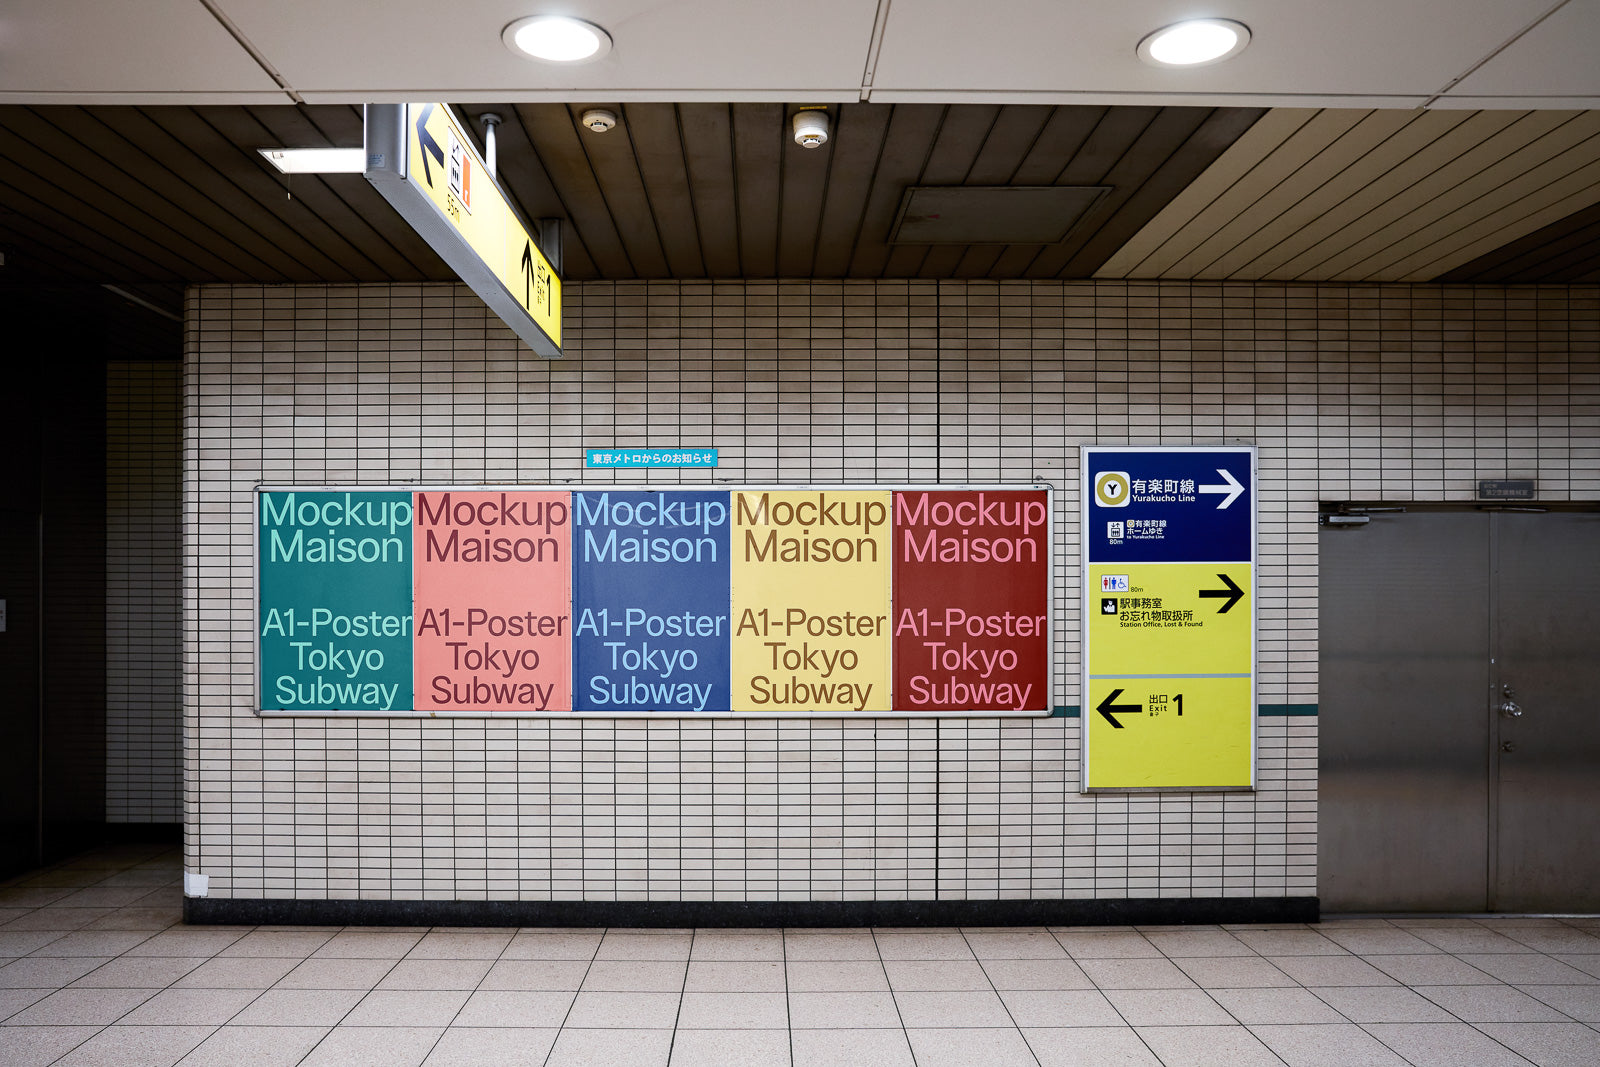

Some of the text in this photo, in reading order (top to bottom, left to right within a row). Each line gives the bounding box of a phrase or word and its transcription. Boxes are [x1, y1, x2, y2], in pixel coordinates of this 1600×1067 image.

[592, 453, 712, 464] 東京メトロからのお知らせ
[1108, 484, 1117, 495] Y
[1132, 479, 1195, 494] 有楽町線
[262, 493, 412, 535] Mockup
[418, 493, 568, 535] Mockup
[576, 493, 726, 535] Mockup
[737, 493, 887, 535] Mockup
[897, 493, 1046, 535] Mockup
[1135, 520, 1167, 528] 有楽町線
[270, 529, 403, 562] Maison
[426, 529, 559, 562] Maison
[584, 529, 717, 562] Maison
[745, 529, 878, 562] Maison
[904, 529, 1037, 562] Maison
[1126, 527, 1164, 535] ホームゆき
[1119, 598, 1162, 609] 駅事務室
[1119, 610, 1193, 622] お忘れ物取扱所
[262, 608, 412, 637] A1-Poster
[418, 608, 569, 637] A1-Poster
[576, 608, 727, 637] A1-Poster
[736, 608, 887, 637] A1-Poster
[896, 608, 1046, 637] A1-Poster
[290, 642, 385, 679] Tokyo
[445, 642, 540, 679] Tokyo
[603, 642, 698, 679] Tokyo
[764, 642, 859, 679] Tokyo
[923, 642, 1018, 679] Tokyo
[275, 676, 398, 711] Subway
[431, 676, 554, 711] Subway
[589, 676, 712, 711] Subway
[750, 676, 873, 711] Subway
[909, 676, 1032, 711] Subway
[1149, 694, 1183, 716] 出口 1
